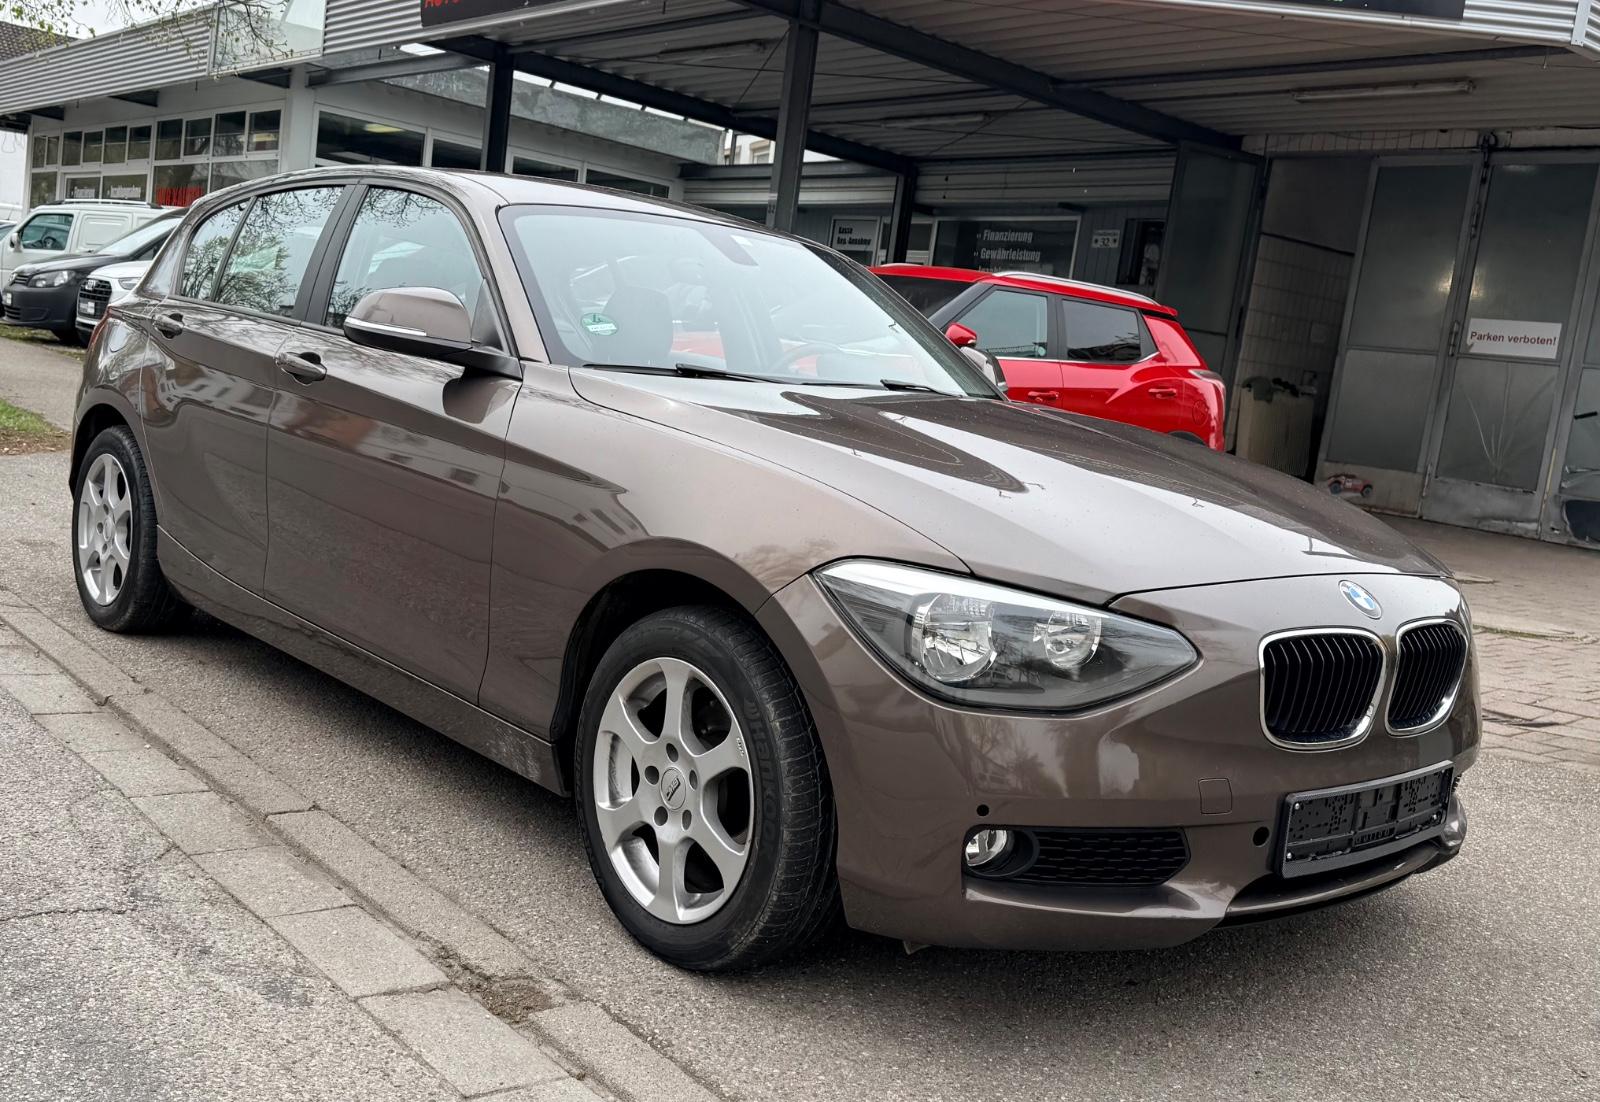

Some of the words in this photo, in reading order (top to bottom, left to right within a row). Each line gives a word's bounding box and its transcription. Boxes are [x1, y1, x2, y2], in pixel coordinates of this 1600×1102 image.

[983, 229, 1034, 243] Finanzierung
[1470, 331, 1505, 342] Parken
[1508, 334, 1557, 346] verboten!
